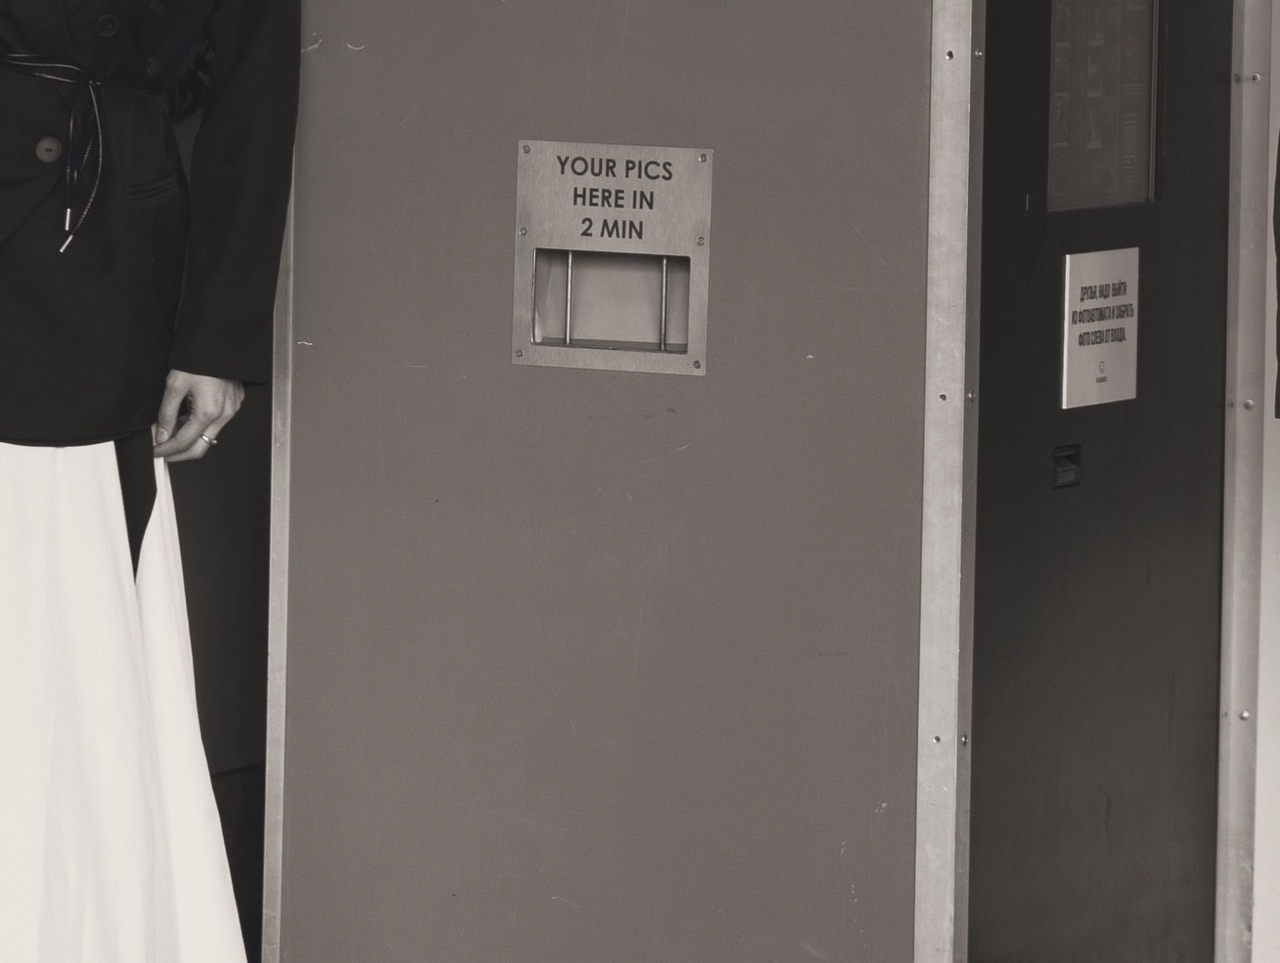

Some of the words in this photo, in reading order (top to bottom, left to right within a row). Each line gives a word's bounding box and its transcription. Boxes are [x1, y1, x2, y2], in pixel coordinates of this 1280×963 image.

[556, 155, 617, 178] YOUR
[624, 159, 673, 181] PICS
[573, 186, 625, 209] HERE
[632, 190, 654, 210] IN
[580, 217, 593, 237] 2
[600, 218, 644, 240] MIN
